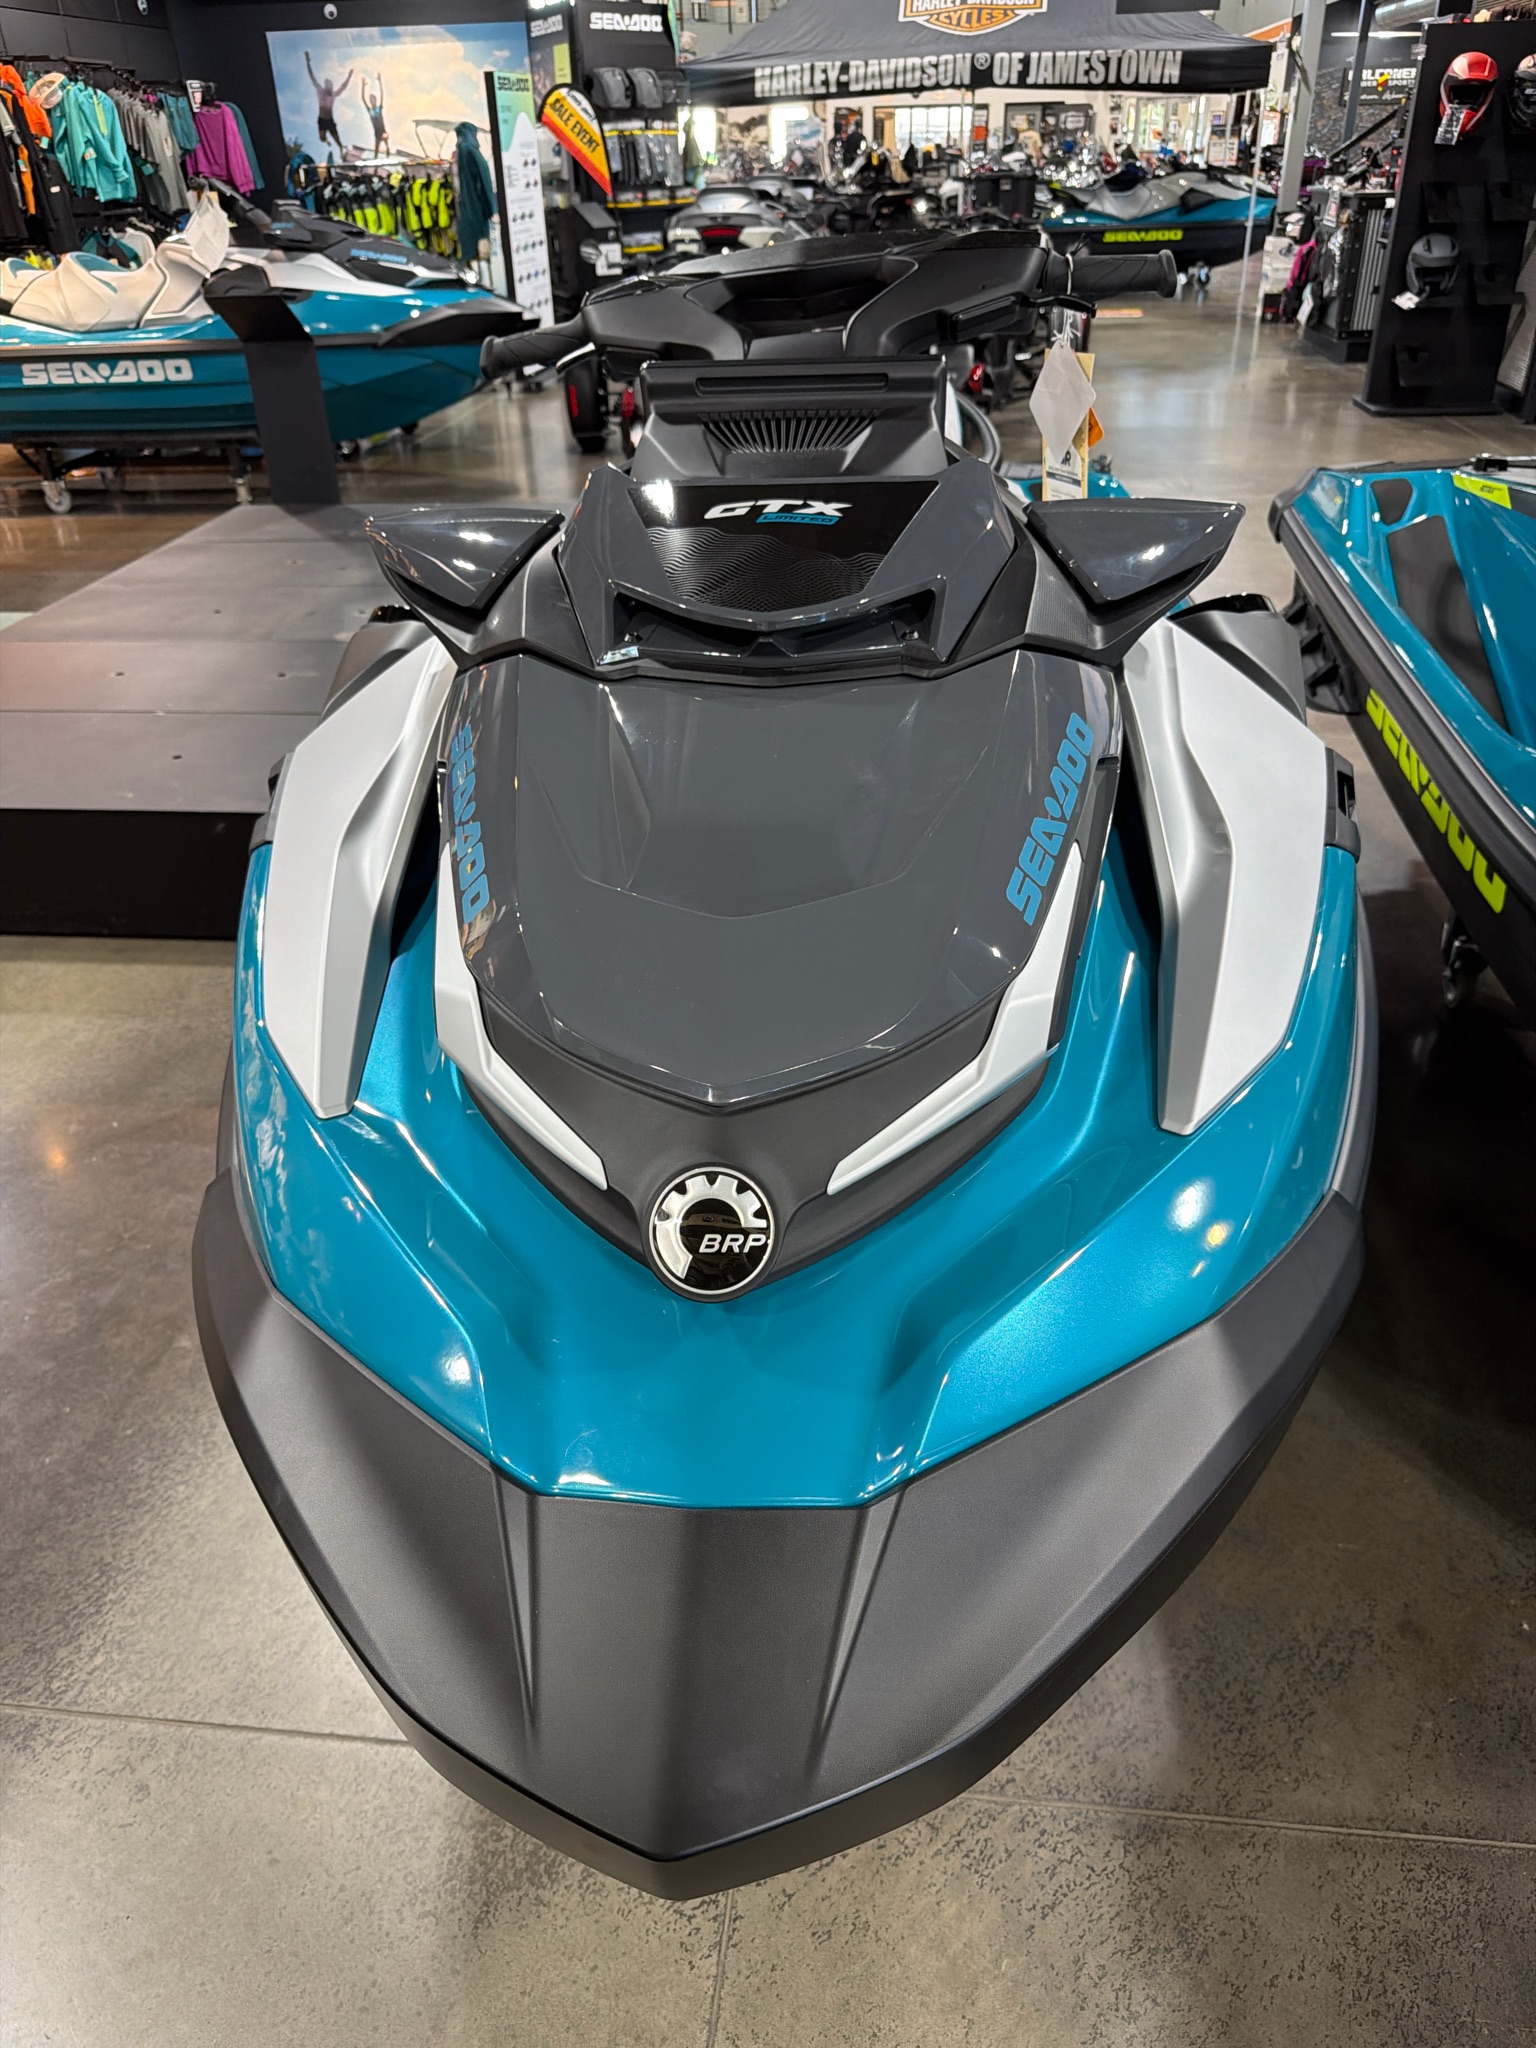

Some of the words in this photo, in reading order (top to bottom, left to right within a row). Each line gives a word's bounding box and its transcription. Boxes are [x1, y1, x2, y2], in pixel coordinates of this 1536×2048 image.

[938, 8, 1002, 28] CYCLES
[992, 52, 1024, 85] OF
[1026, 50, 1183, 84] JAMESTOWN
[550, 98, 574, 127] SALE
[571, 120, 600, 154] EVENT
[704, 499, 854, 520] GTX
[762, 514, 834, 523] LIMITED
[699, 1233, 767, 1253] BRP
